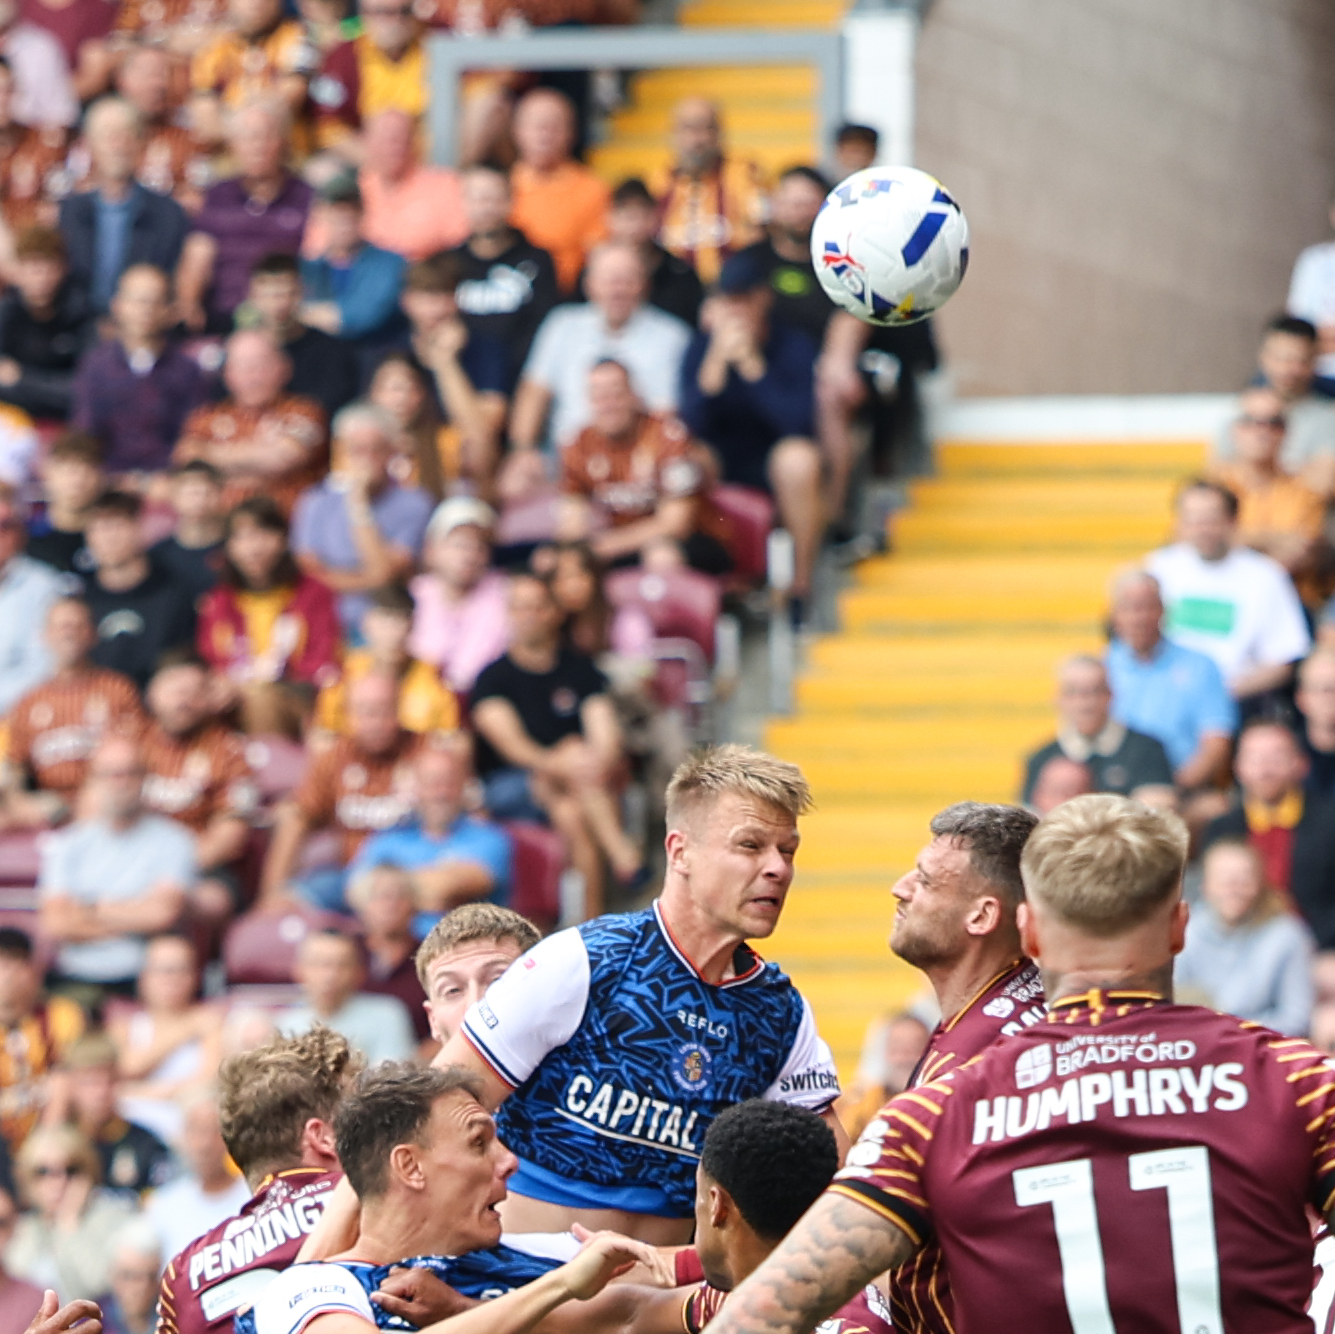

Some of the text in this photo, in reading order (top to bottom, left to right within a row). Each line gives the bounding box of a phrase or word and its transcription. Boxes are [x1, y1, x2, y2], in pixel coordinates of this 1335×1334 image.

[676, 1009, 728, 1038] REFLO
[1055, 1034, 1137, 1054] UNIVERSITY
[1056, 1040, 1197, 1077] BRADFORD
[566, 1074, 699, 1151] CAPITAL
[971, 1063, 1249, 1145] HUMPHRYS
[189, 1190, 336, 1291] PENNINGT
